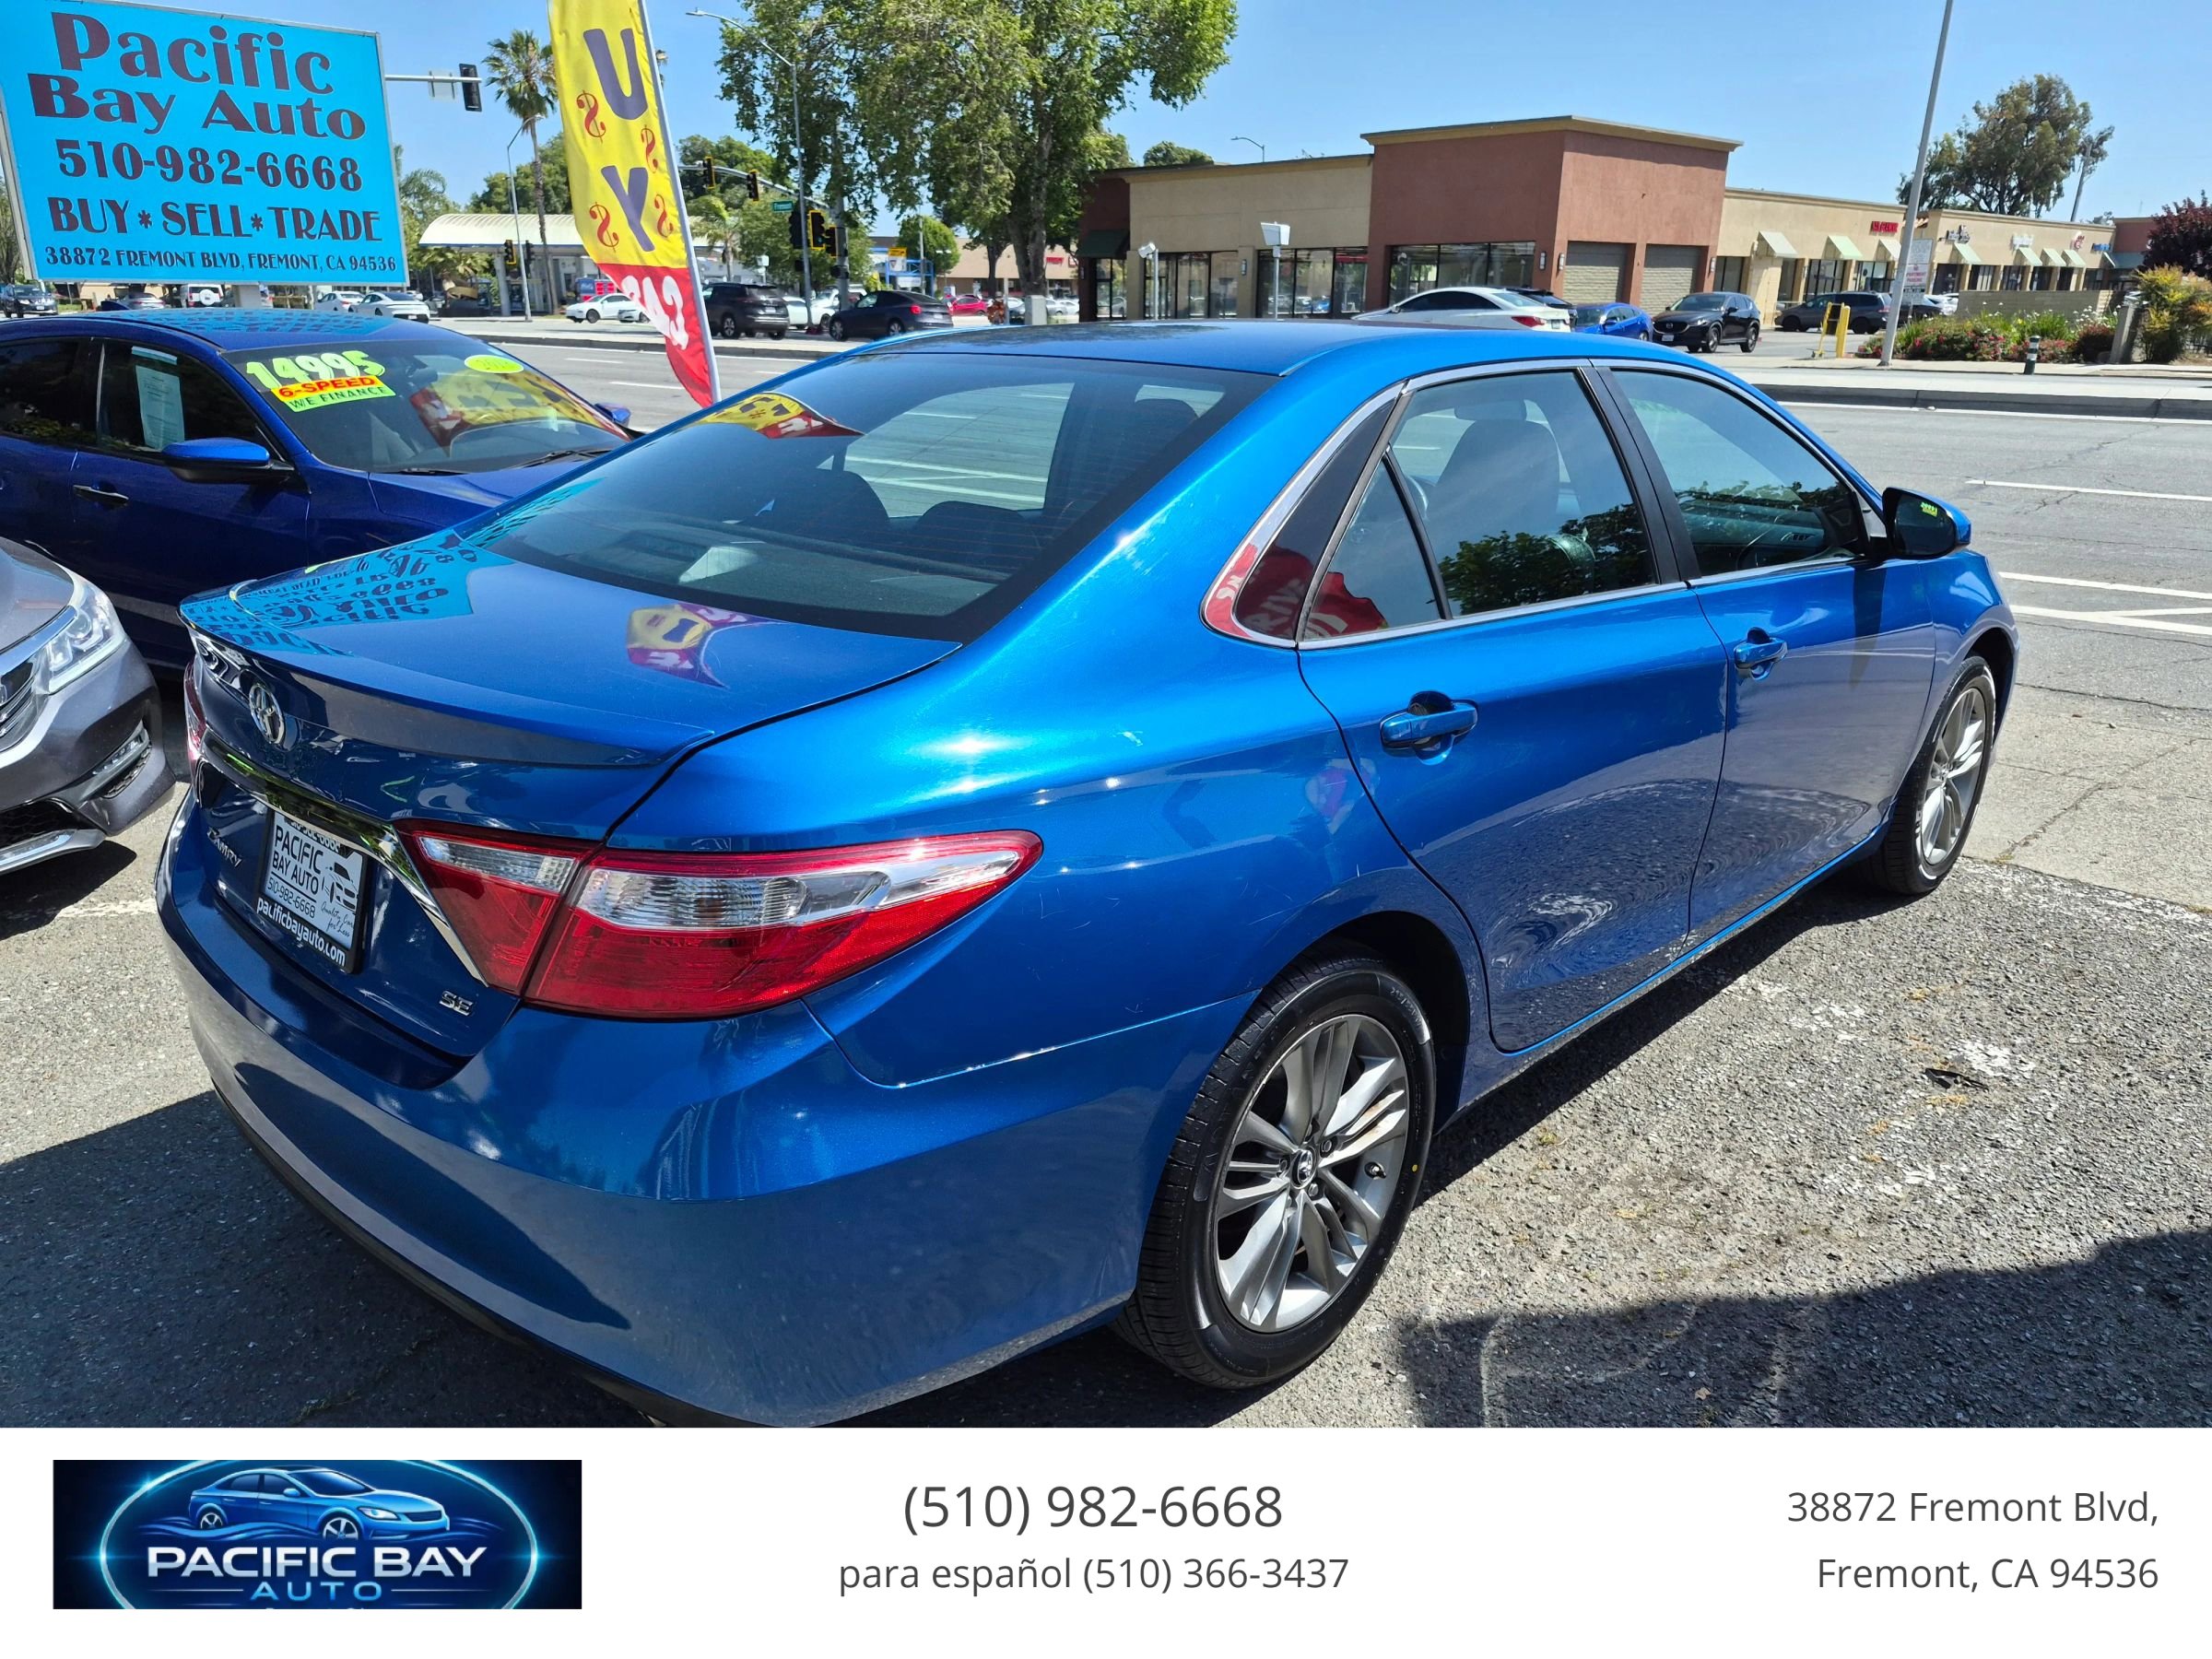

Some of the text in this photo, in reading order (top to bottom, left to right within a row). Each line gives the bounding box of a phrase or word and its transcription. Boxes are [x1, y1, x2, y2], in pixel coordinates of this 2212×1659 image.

[51, 12, 335, 95] Pacific
[28, 73, 367, 140] Bay Auto
[55, 138, 362, 192] 510-982-6668
[48, 196, 382, 241] BUY SELL TRADE
[45, 245, 396, 272] 38872 FREMONT BLVD, FREMONT, CA 94536
[246, 350, 386, 389] 14995
[278, 377, 377, 398] 6-SPEED
[288, 386, 387, 409] WE FINANCE
[275, 826, 324, 875] PACIFIC
[272, 851, 319, 896] BAY AUTO
[267, 877, 316, 919] 510-982-6668
[257, 897, 347, 967] pacificbayauto.com
[440, 990, 474, 1017] SE
